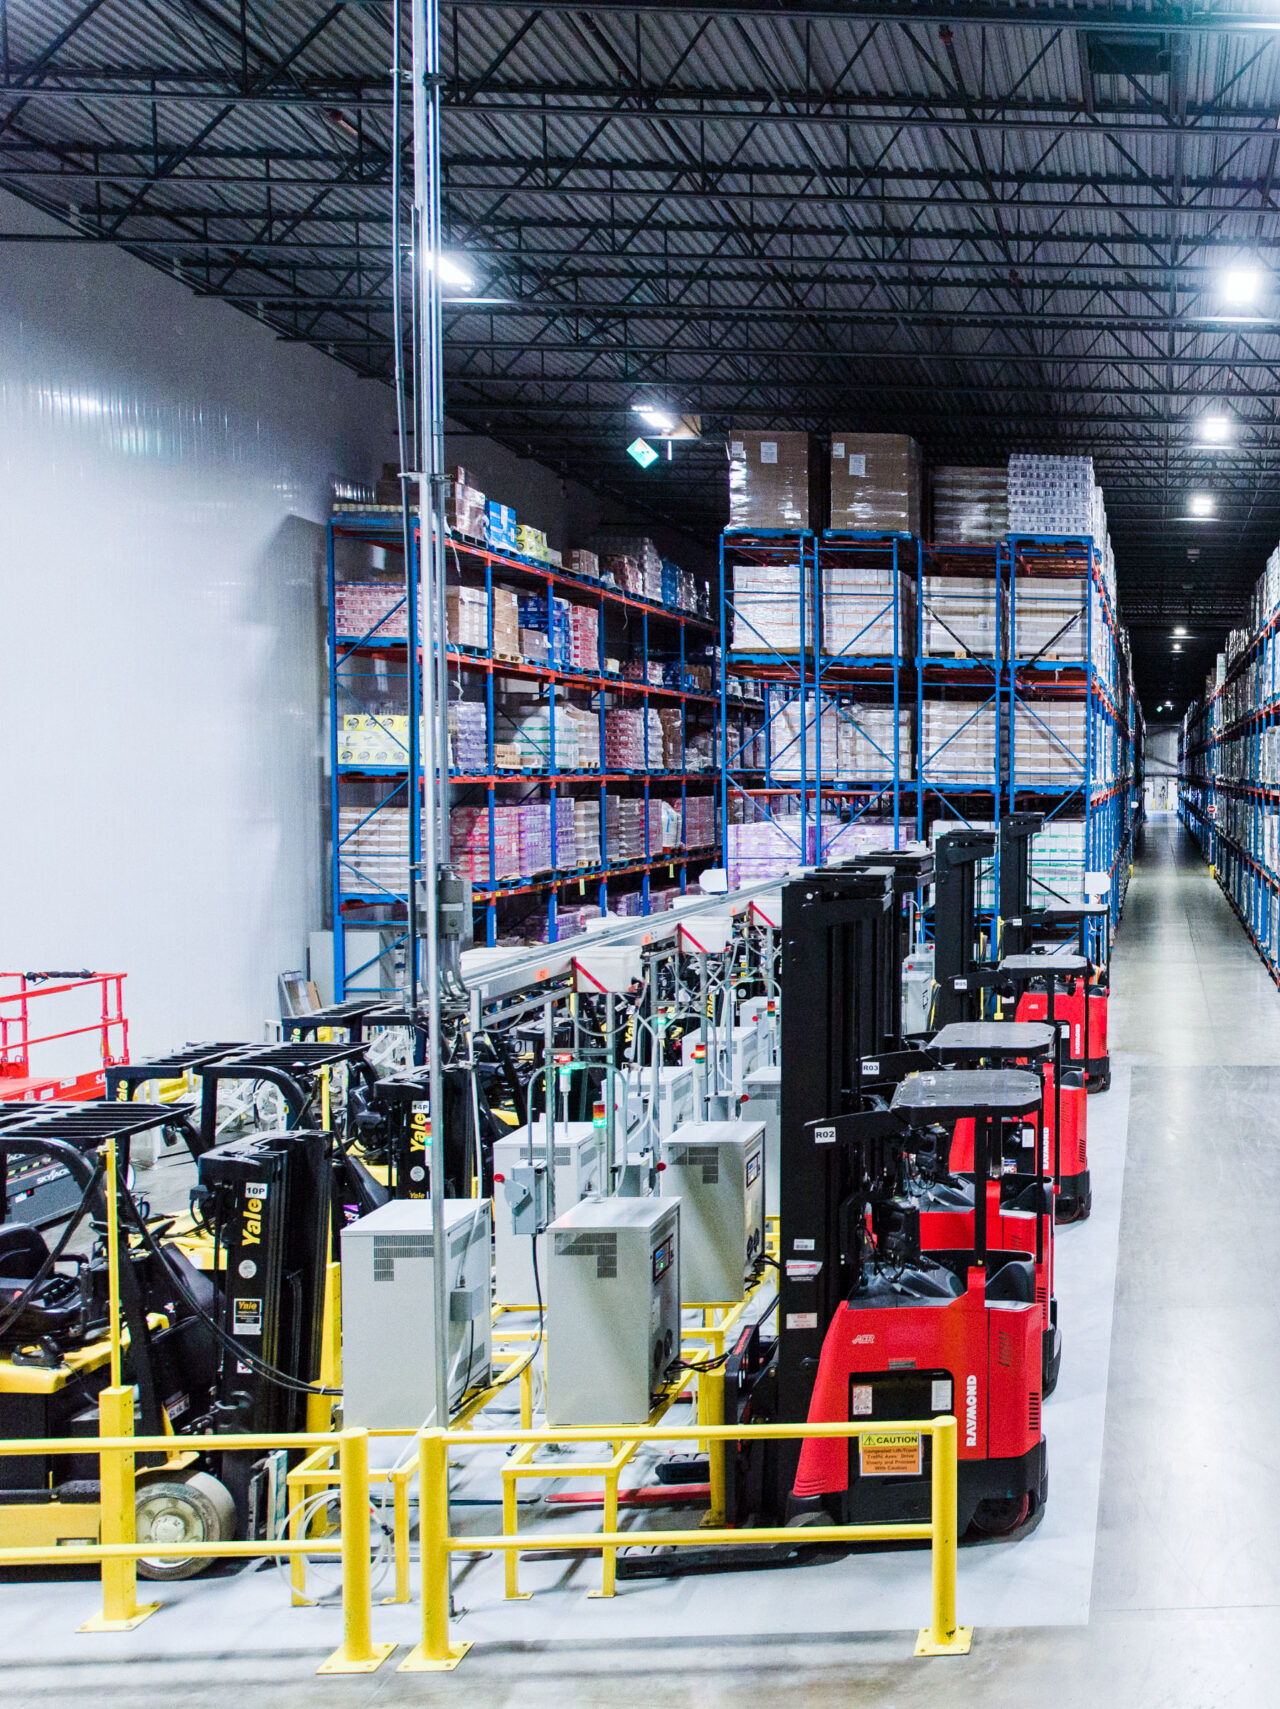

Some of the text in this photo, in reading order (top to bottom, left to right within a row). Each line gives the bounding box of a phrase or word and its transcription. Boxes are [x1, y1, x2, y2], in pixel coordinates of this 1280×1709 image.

[410, 1113, 426, 1152] Yale
[242, 1198, 262, 1246] Yale
[238, 1301, 257, 1310] Yale
[966, 1374, 977, 1447] RAYMOND
[876, 1436, 918, 1444] CAUTION
